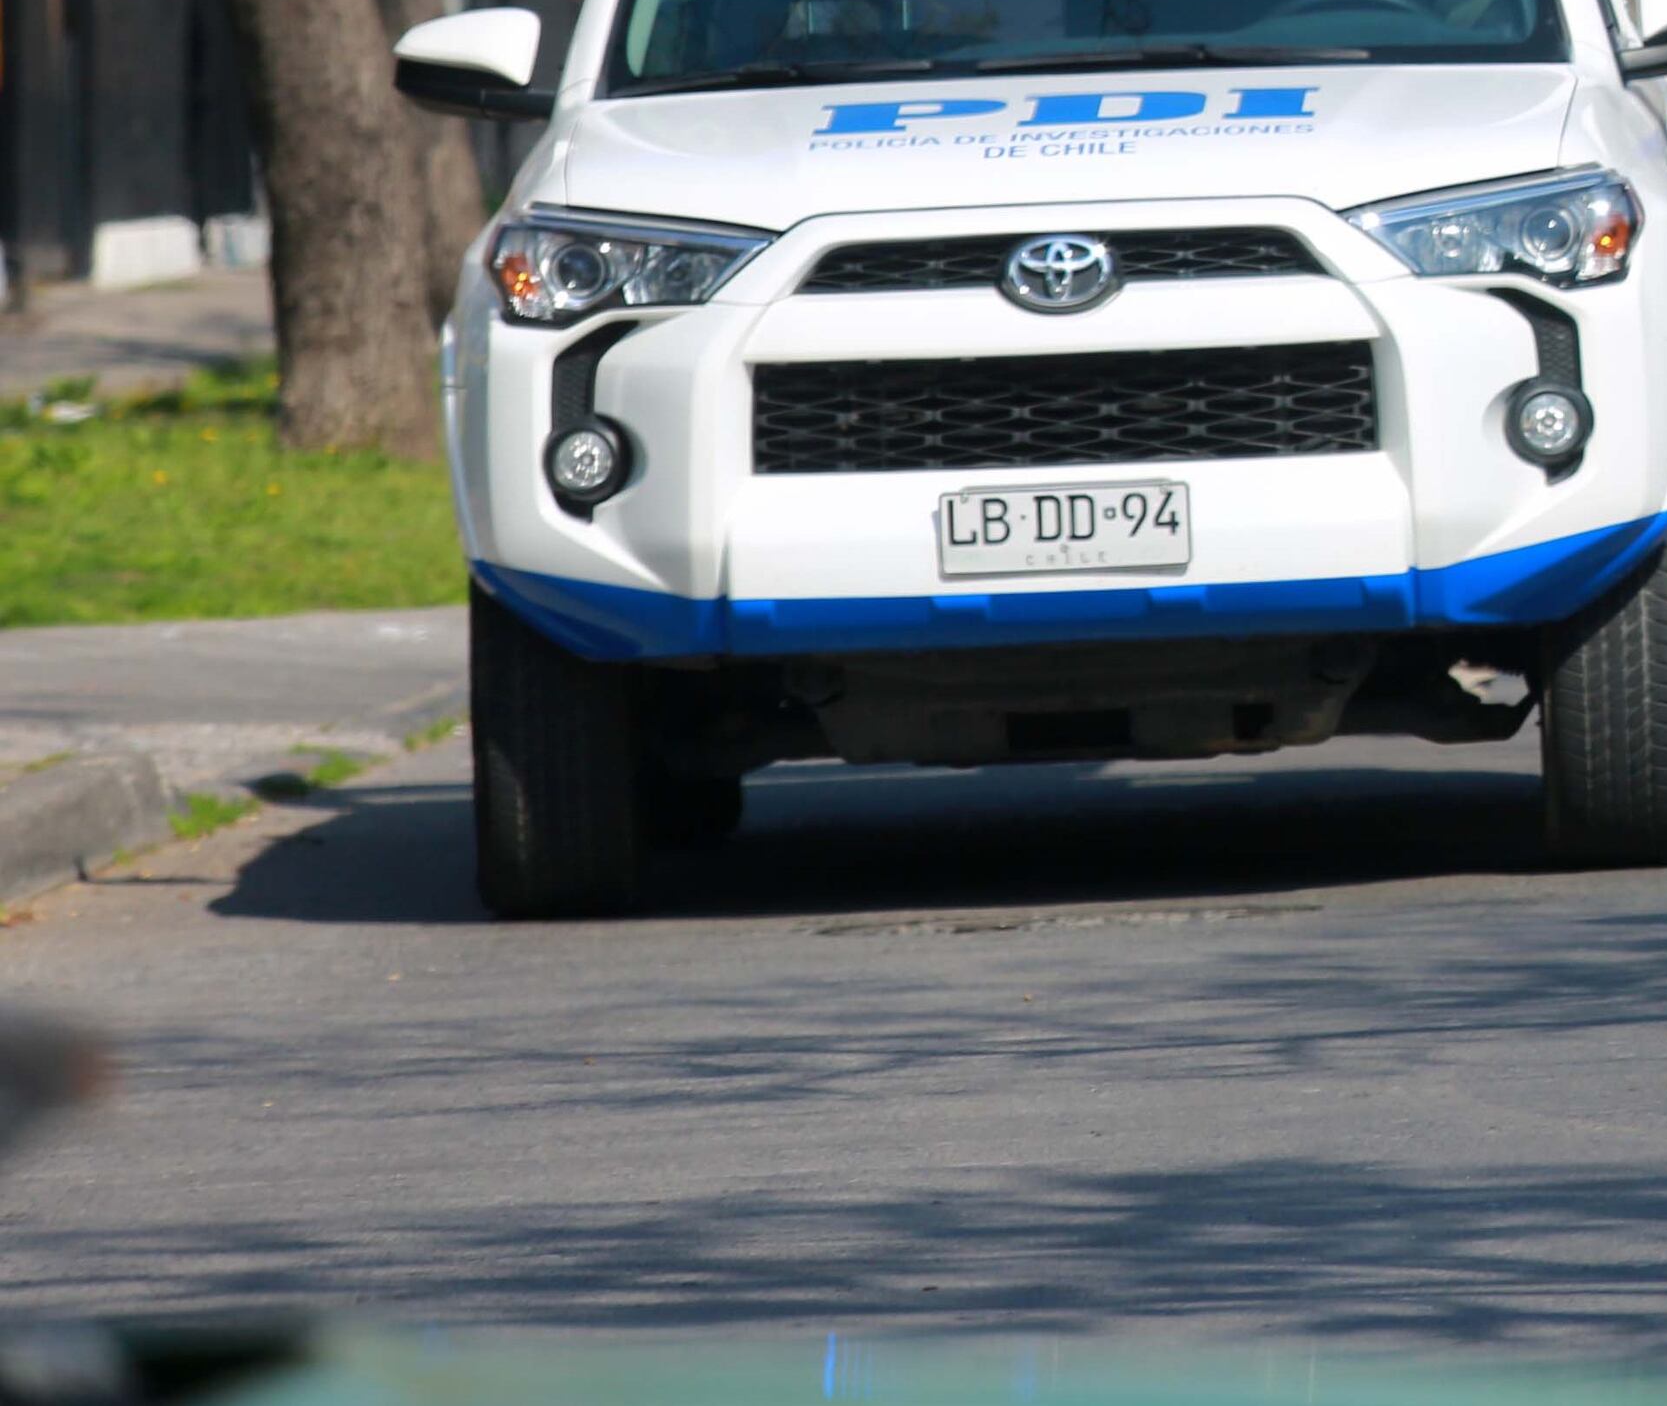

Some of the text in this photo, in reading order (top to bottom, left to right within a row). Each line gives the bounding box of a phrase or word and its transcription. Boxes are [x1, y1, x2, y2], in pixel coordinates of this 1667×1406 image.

[813, 86, 1320, 136] PDI
[808, 123, 1316, 152] POLICÍA DE INVESTIGACIONES
[983, 141, 1138, 159] DE CHILE
